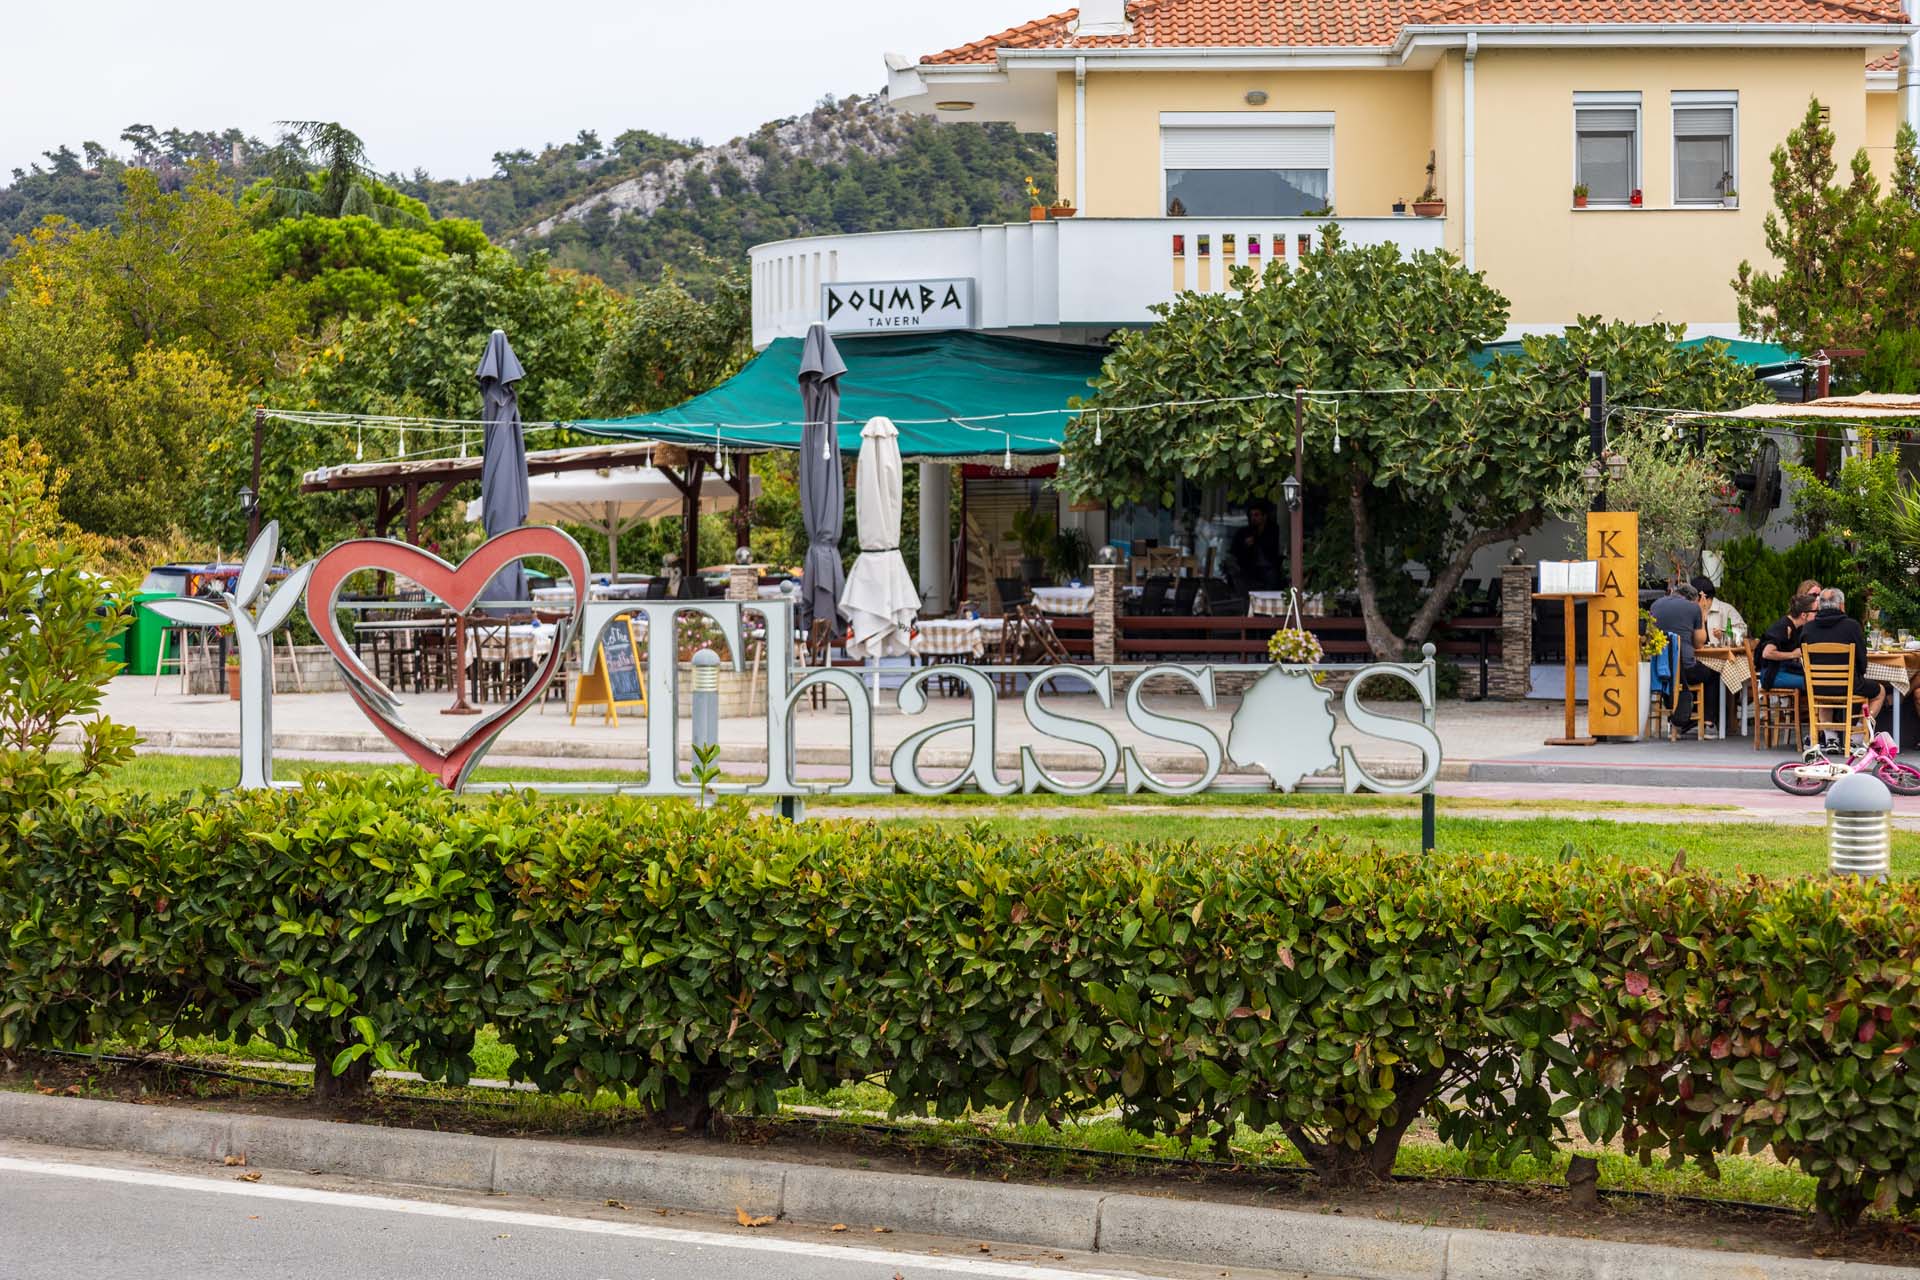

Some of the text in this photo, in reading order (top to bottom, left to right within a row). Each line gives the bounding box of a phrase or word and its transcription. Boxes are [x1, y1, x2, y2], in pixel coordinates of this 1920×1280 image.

[828, 283, 962, 321] DOUMBA
[868, 316, 920, 327] TAVERN
[1597, 530, 1626, 717] KARAS
